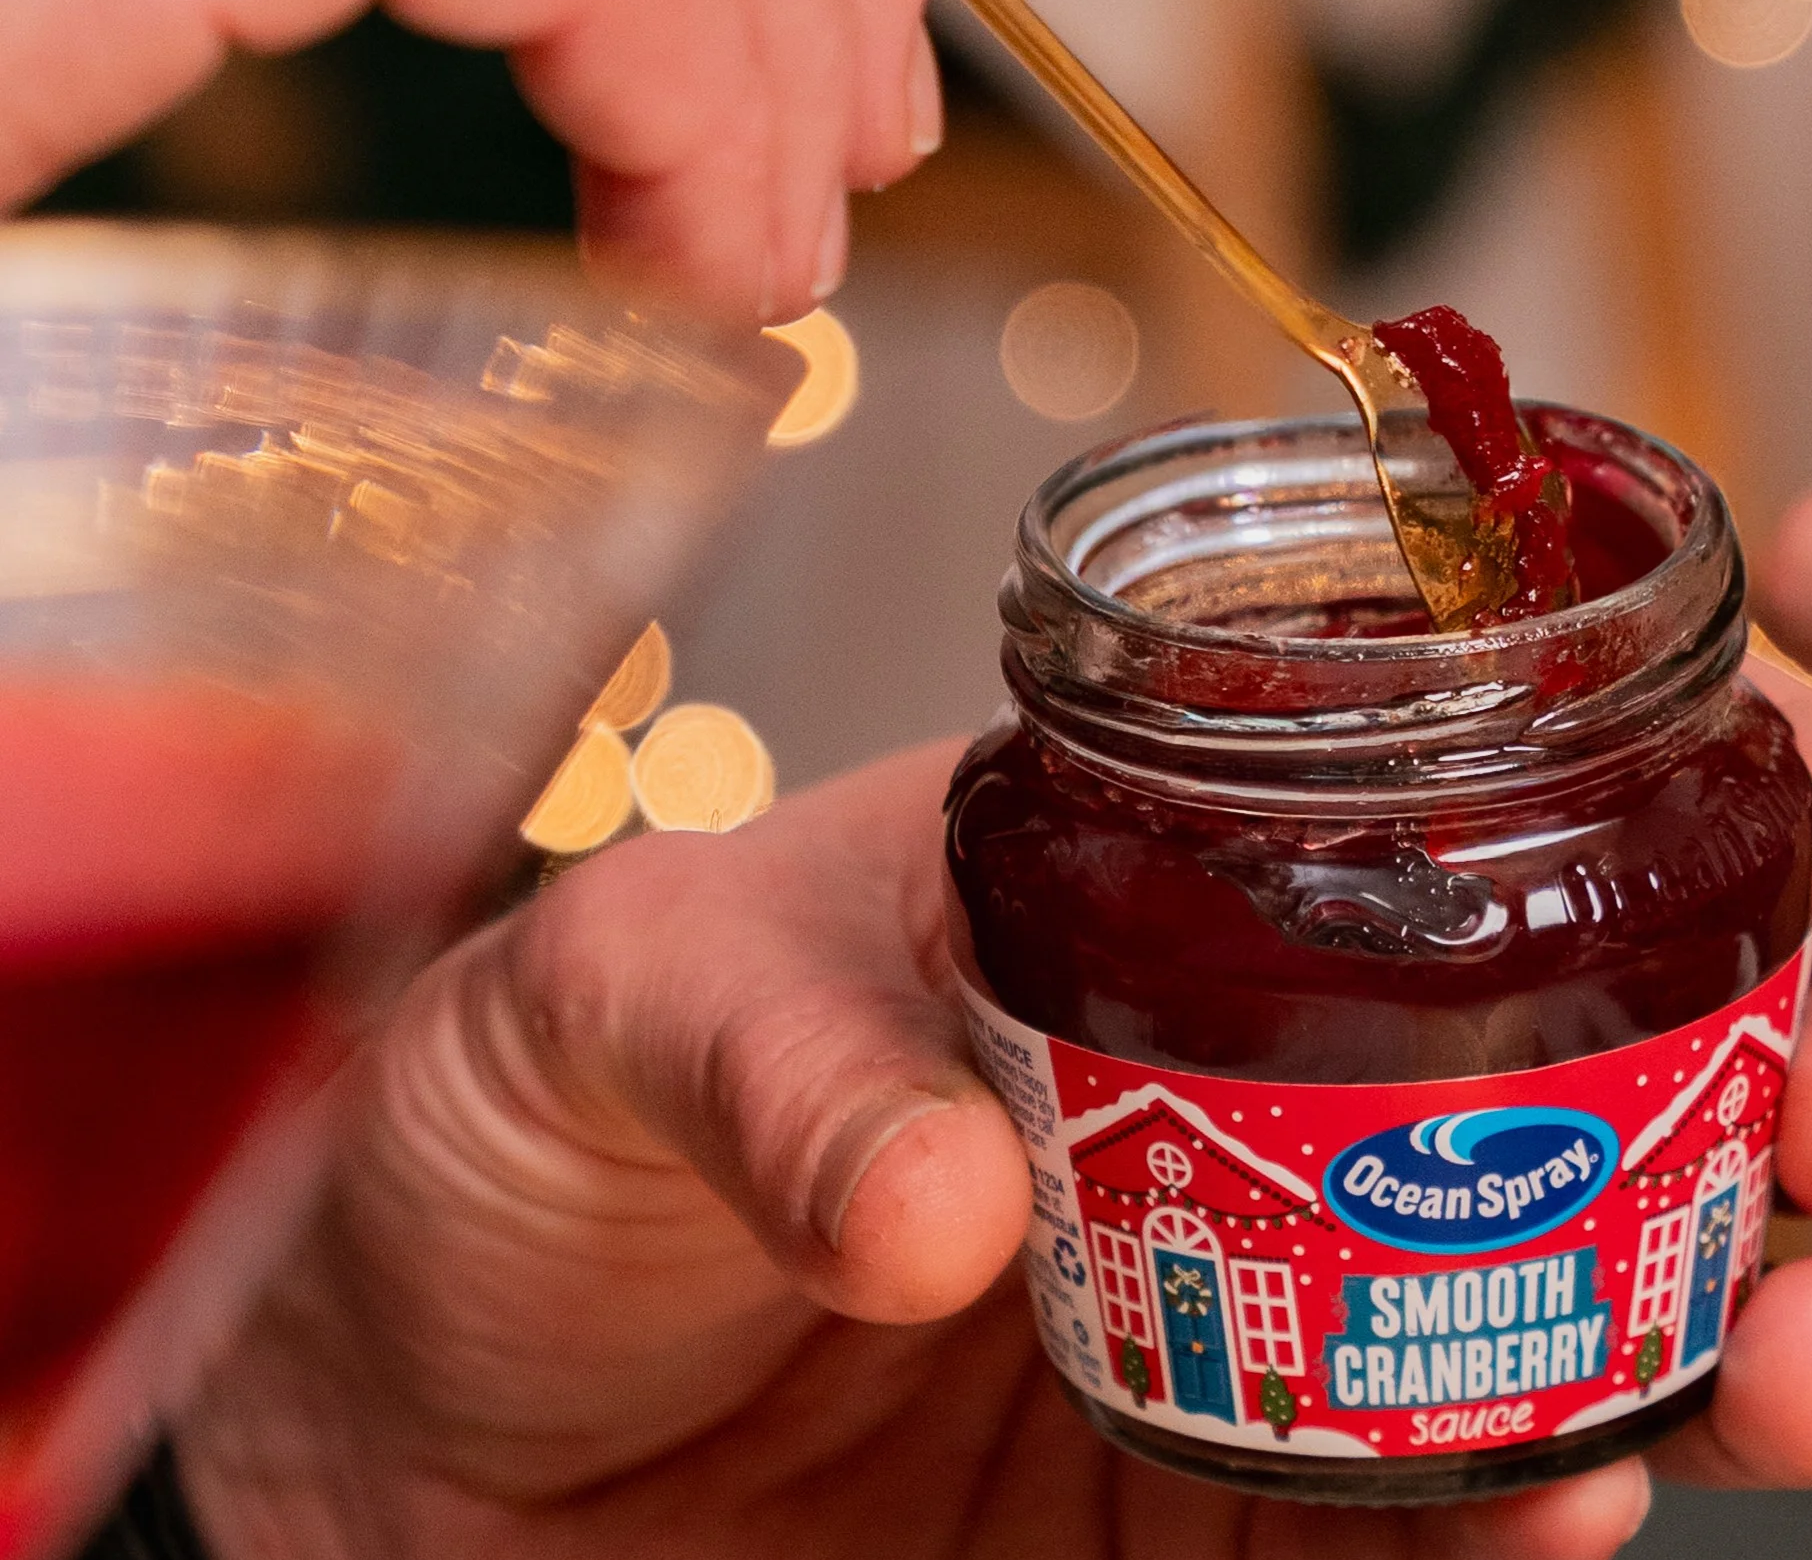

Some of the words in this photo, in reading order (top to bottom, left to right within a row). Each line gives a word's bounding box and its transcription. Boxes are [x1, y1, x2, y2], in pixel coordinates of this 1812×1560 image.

[1343, 1154, 1471, 1220] Ocean
[1476, 1137, 1588, 1220] Spray
[1369, 1255, 1576, 1339] SMOOTH
[1333, 1313, 1606, 1408] CRANBERRY
[1408, 1400, 1536, 1447] sauce
